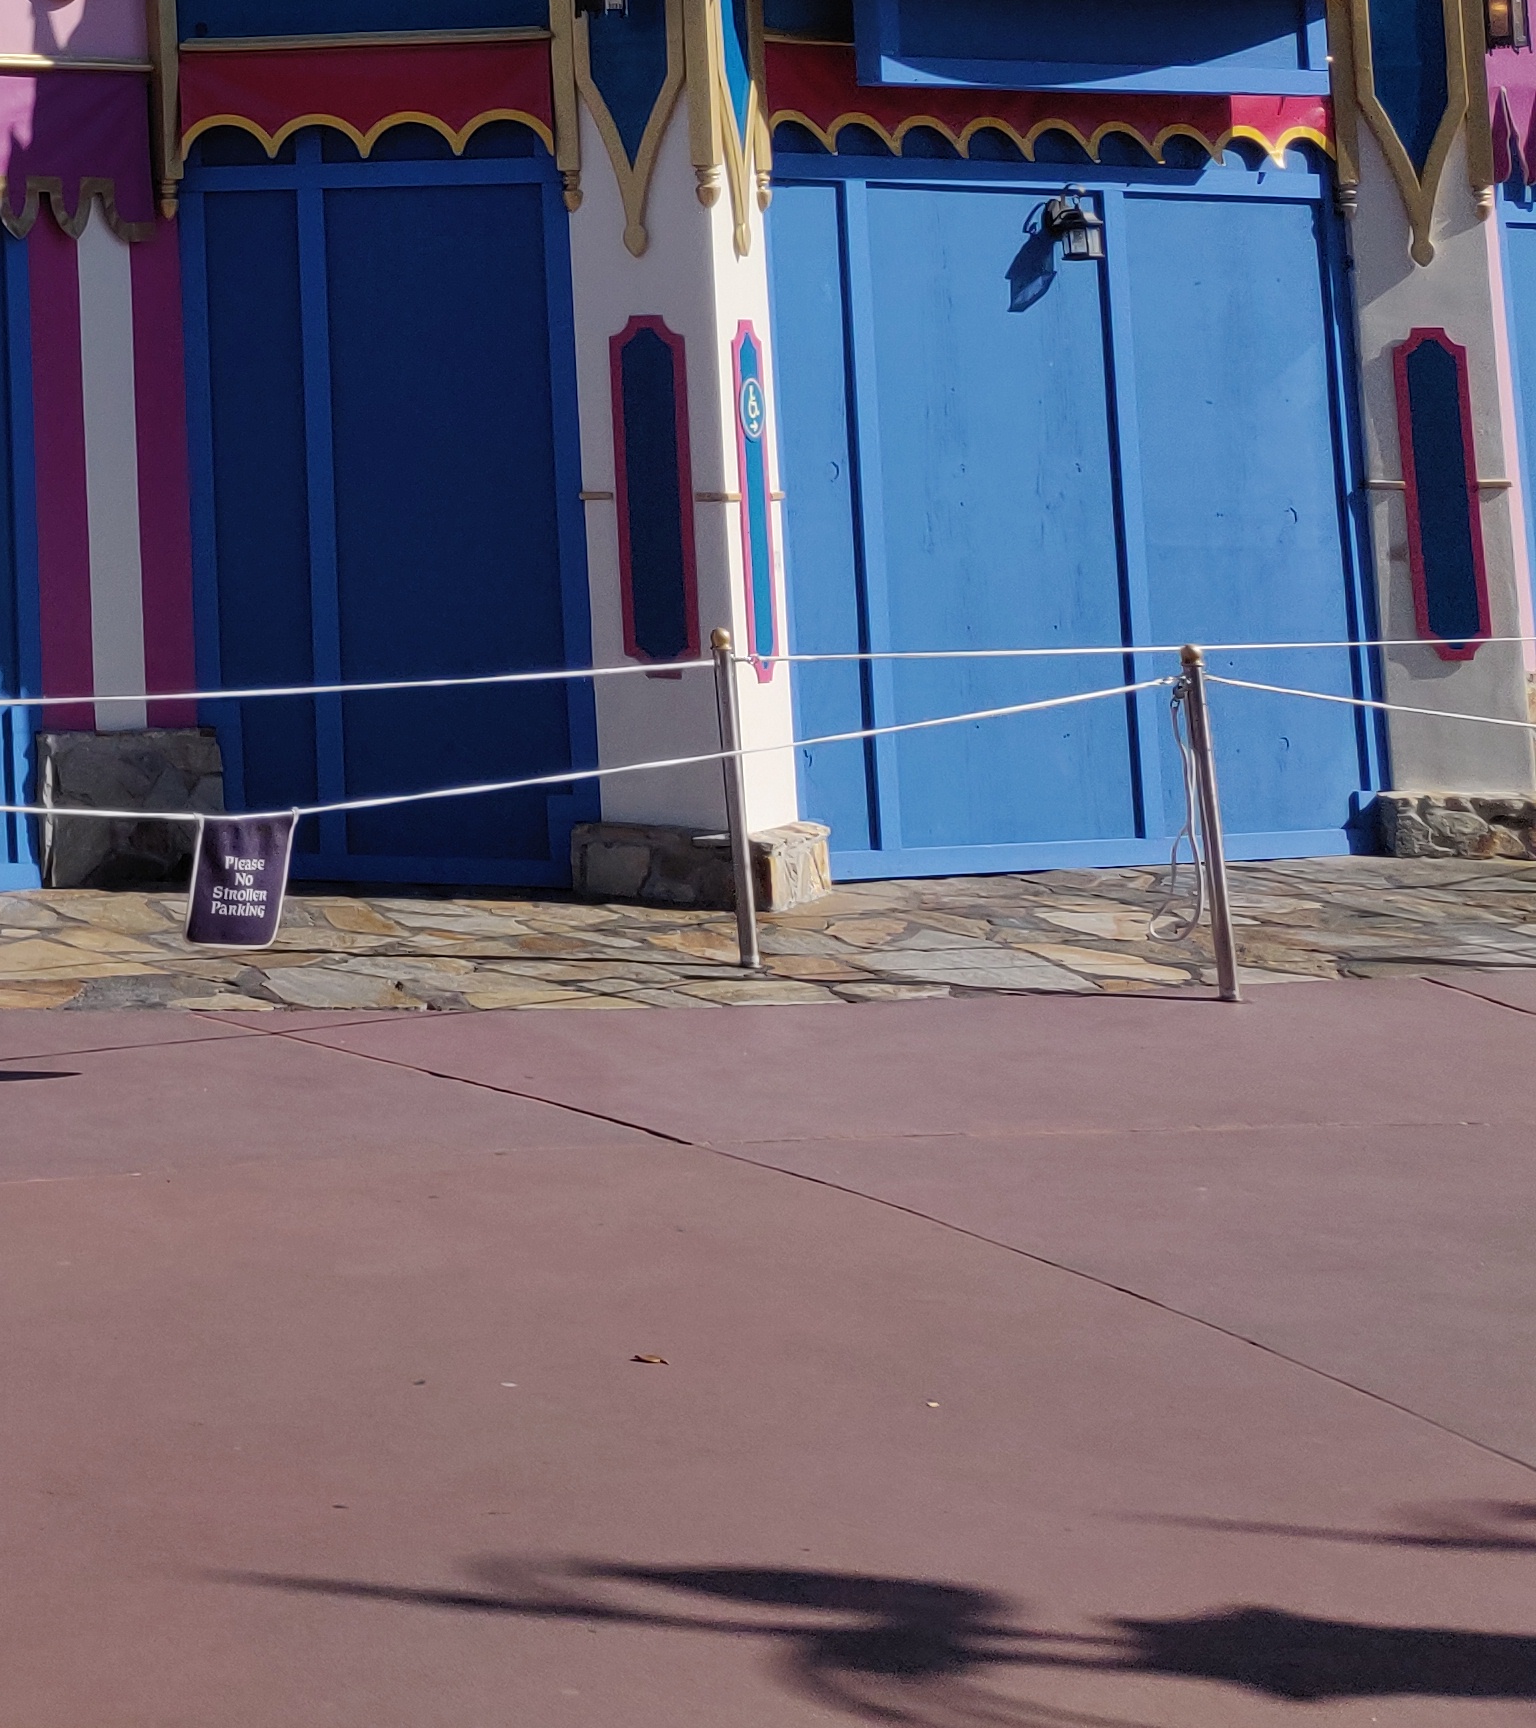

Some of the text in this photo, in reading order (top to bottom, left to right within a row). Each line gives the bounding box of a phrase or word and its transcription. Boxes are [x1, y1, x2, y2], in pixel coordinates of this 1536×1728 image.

[224, 855, 265, 871] Please
[212, 885, 268, 902] Stroller
[211, 900, 266, 919] Parking
